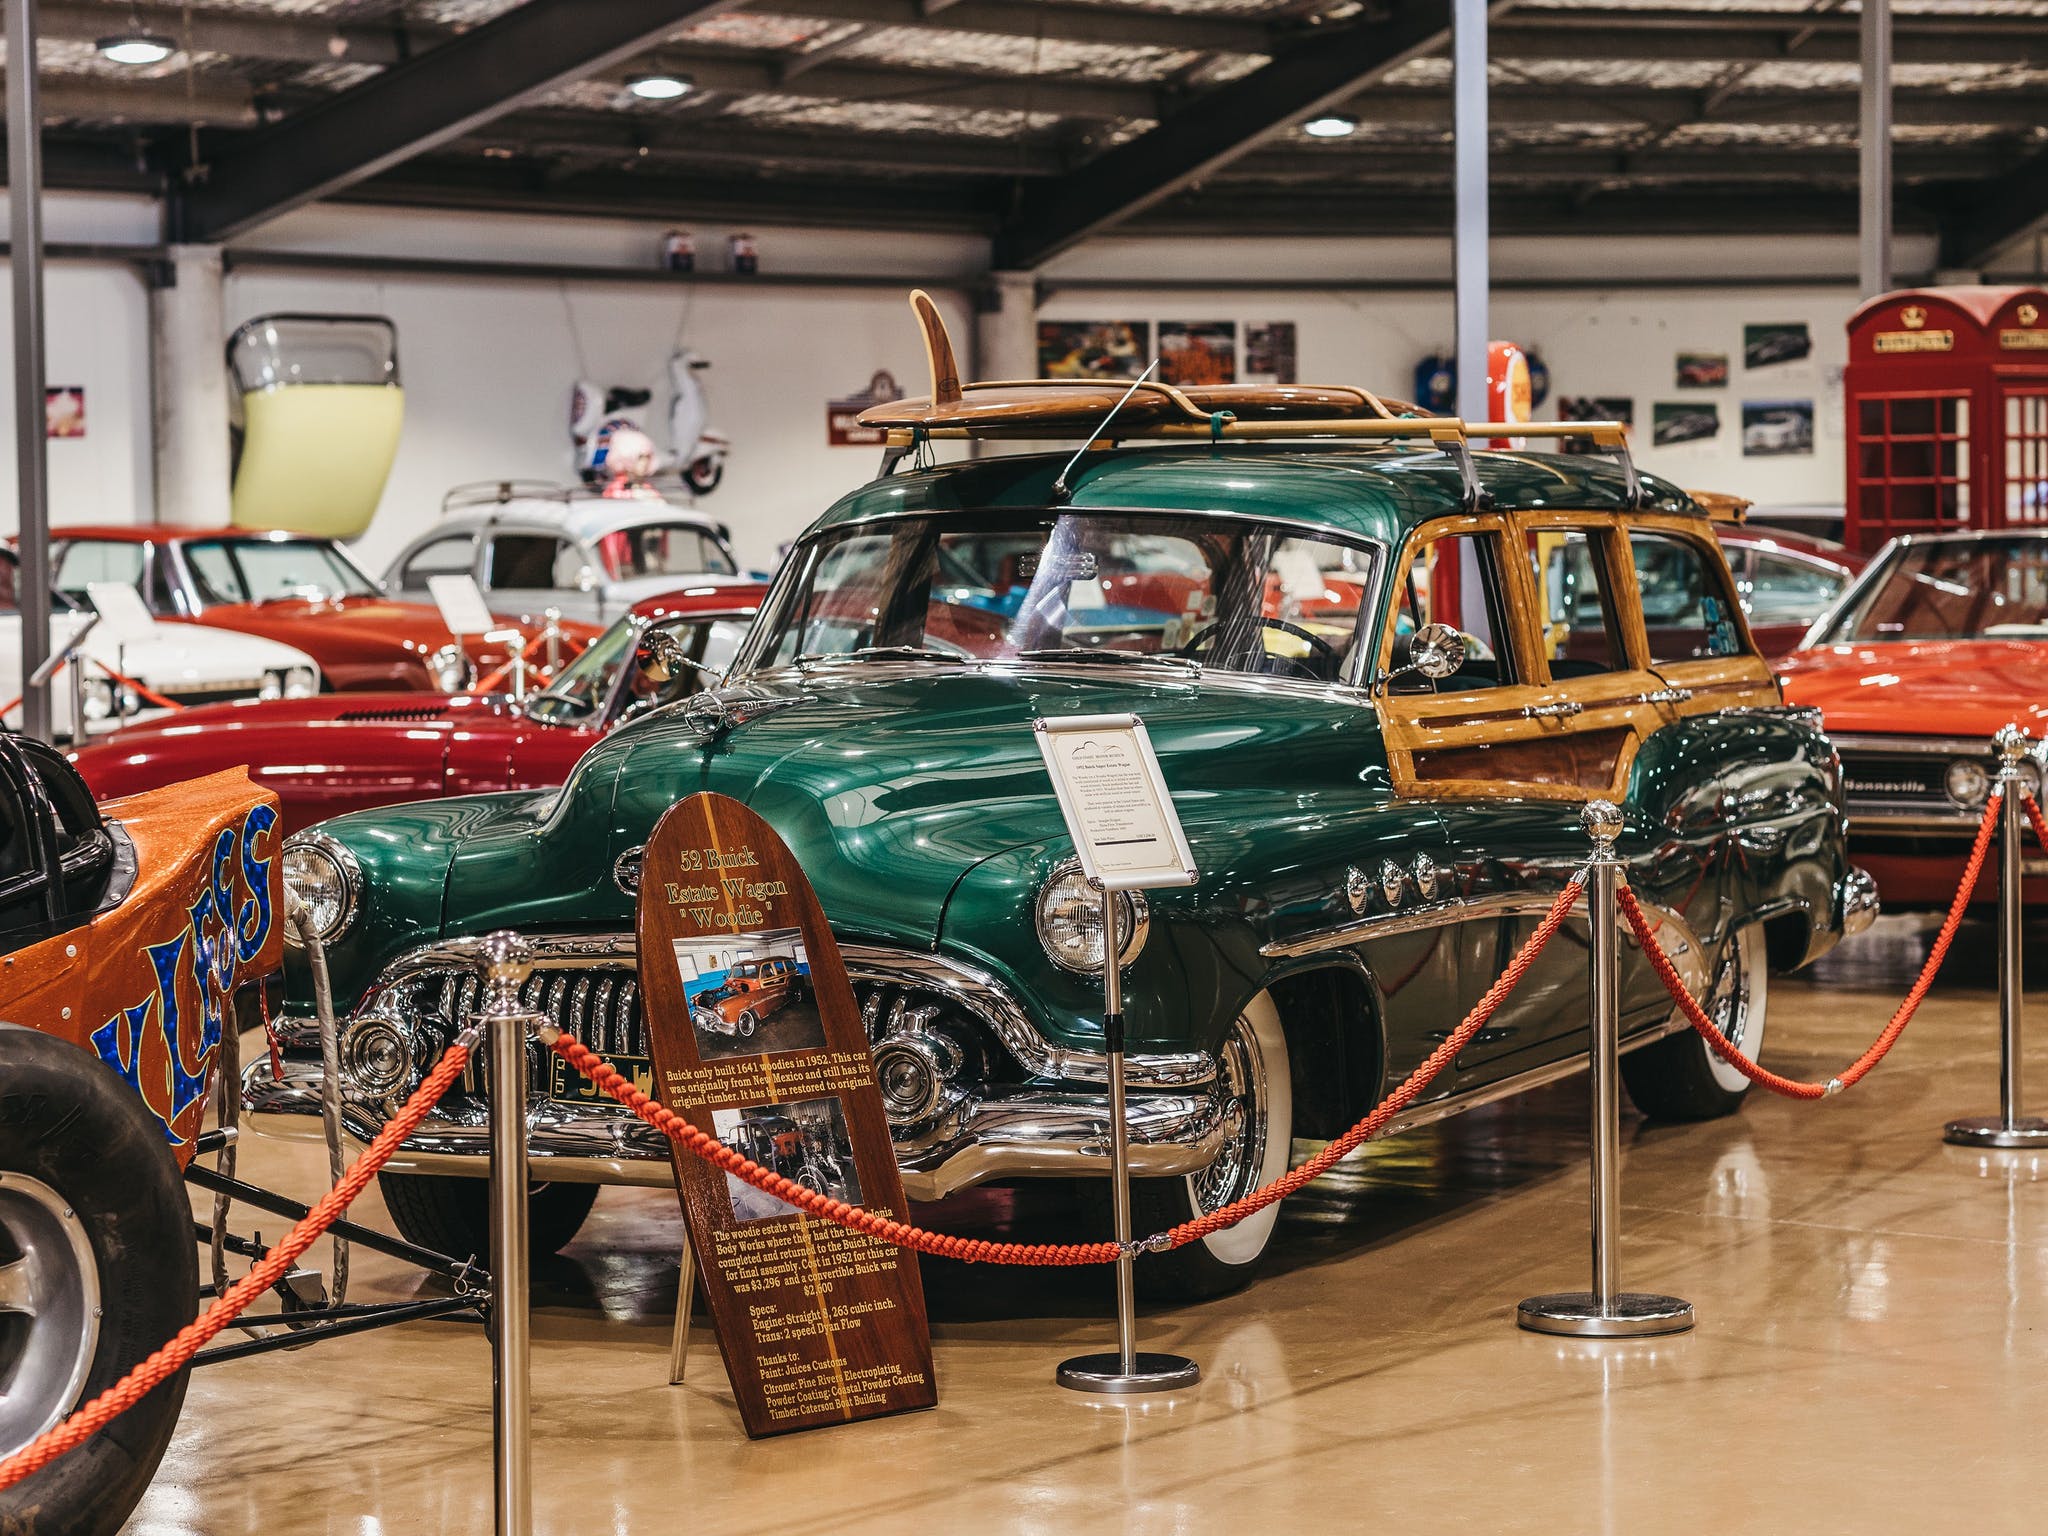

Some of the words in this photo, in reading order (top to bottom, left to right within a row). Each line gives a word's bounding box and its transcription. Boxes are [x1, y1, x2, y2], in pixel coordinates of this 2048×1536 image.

[681, 850, 702, 871] 52
[703, 846, 759, 869] Buick
[665, 883, 719, 904] Estate
[720, 878, 788, 903] Wagon
[666, 1069, 692, 1081] Buick
[694, 1068, 712, 1079] only
[714, 1065, 736, 1076] built
[737, 1063, 758, 1073] 1641
[760, 1059, 795, 1071] woodies
[796, 1058, 805, 1067] in
[806, 1055, 831, 1066] 1952.
[832, 1053, 851, 1063] This
[669, 1086, 686, 1094] was
[688, 1079, 728, 1094] originally
[731, 1078, 752, 1087] from
[752, 1074, 772, 1085] New
[772, 1072, 803, 1083] Mexico
[805, 1068, 821, 1079] and
[823, 1066, 840, 1077] still
[841, 1066, 857, 1075] has
[858, 1064, 870, 1073] its
[672, 1094, 706, 1109] original
[707, 1092, 739, 1103] timber.
[740, 1090, 748, 1100] It
[749, 1089, 765, 1099] has
[766, 1087, 787, 1097] been
[789, 1081, 825, 1094] restored
[827, 1081, 836, 1089] to
[838, 1076, 873, 1090] original.
[713, 1229, 730, 1241] The
[731, 1226, 760, 1239] woodie
[762, 1223, 786, 1234] estate
[789, 1220, 819, 1232] wagons
[716, 1243, 737, 1255] Body
[739, 1239, 765, 1251] Works
[767, 1237, 792, 1247] where
[793, 1231, 813, 1245] they
[813, 1229, 829, 1241] had
[831, 1228, 844, 1238] the
[718, 1252, 761, 1268] completed
[763, 1250, 778, 1261] and
[780, 1244, 816, 1259] returned
[817, 1244, 826, 1253] to
[828, 1241, 842, 1251] the
[842, 1237, 867, 1249] Buick
[726, 1271, 738, 1280] for
[738, 1266, 759, 1278] final
[760, 1261, 800, 1275] assembly.
[802, 1257, 821, 1269] Cost
[822, 1256, 831, 1266] in
[832, 1252, 852, 1264] 1952
[854, 1251, 865, 1261] for
[867, 1248, 884, 1259] this
[885, 1248, 898, 1256] car
[734, 1284, 750, 1293] was
[751, 1277, 780, 1291] $3,296
[785, 1274, 800, 1285] and
[808, 1266, 854, 1281] convertible
[855, 1262, 879, 1274] Buick
[881, 1261, 897, 1270] was
[750, 1305, 777, 1318] Specs:
[752, 1317, 785, 1331] Engine:
[786, 1310, 821, 1324] Straight
[832, 1305, 848, 1317] 263
[850, 1302, 873, 1314] cubic
[874, 1298, 896, 1310] inch.
[756, 1332, 783, 1343] Trans:
[784, 1329, 790, 1339] 2
[792, 1324, 816, 1340] speed
[840, 1319, 860, 1329] Flow
[757, 1354, 787, 1366] Thanks
[788, 1353, 799, 1361] to:
[760, 1368, 784, 1379] Paint:
[812, 1358, 847, 1370] Customs
[764, 1382, 797, 1394] Chrome:
[798, 1378, 816, 1388] Pine
[844, 1364, 901, 1382] Electroplating
[766, 1395, 795, 1407] Powder
[797, 1390, 830, 1402] Coating:
[832, 1382, 861, 1396] Coastal
[862, 1378, 890, 1391] Powder
[893, 1373, 924, 1385] Coating
[770, 1408, 799, 1419] Timber:
[835, 1397, 853, 1408] Boat
[854, 1393, 886, 1405] Building
